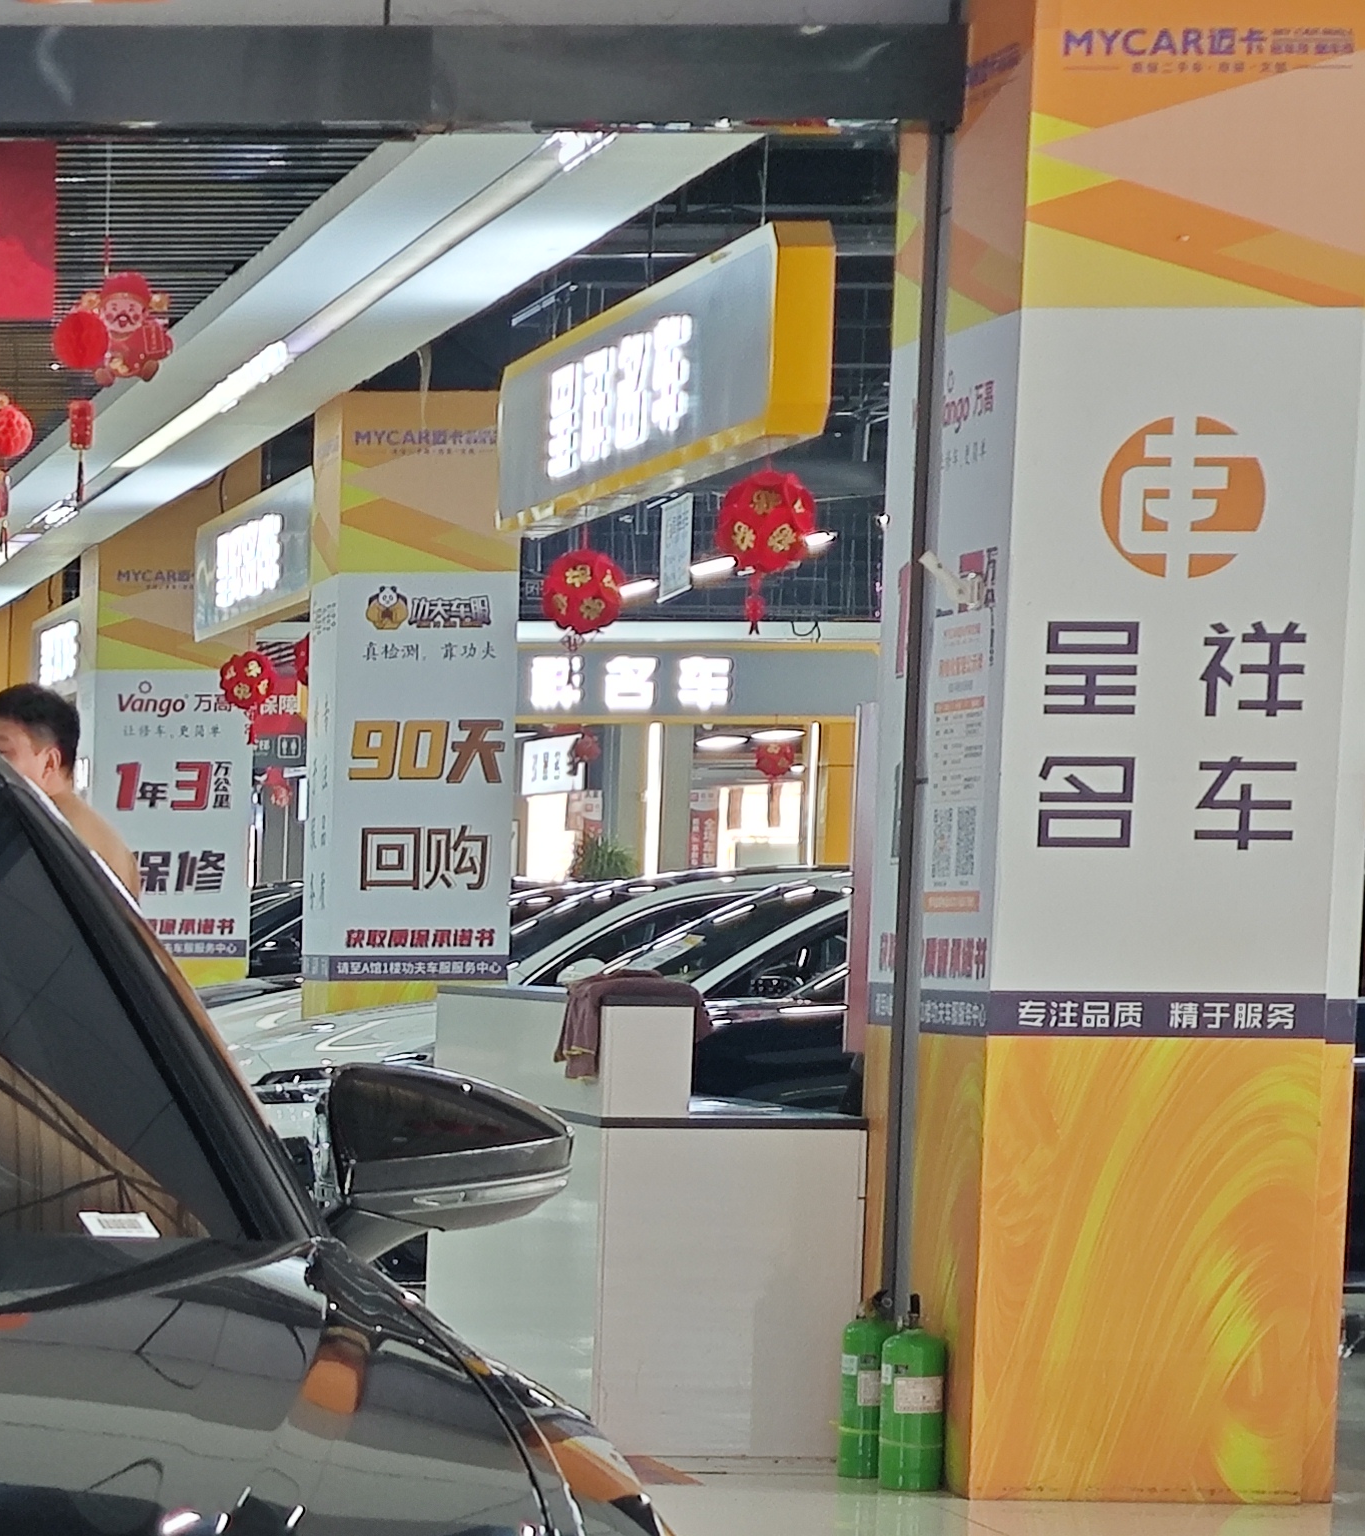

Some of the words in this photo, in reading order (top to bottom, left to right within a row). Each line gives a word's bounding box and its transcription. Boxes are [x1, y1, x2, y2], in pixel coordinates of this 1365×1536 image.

[118, 693, 185, 717] Vango
[260, 695, 300, 715] 保障
[349, 720, 506, 784] 90天
[360, 825, 490, 891] 回购
[135, 850, 226, 895] 保修
[346, 928, 496, 948] 获取质保承诺书
[337, 960, 502, 976] 请至A馆1楼功夫车服服务中心
[1018, 1001, 1144, 1029] 专注品质
[1170, 1003, 1296, 1030] 精于服务
